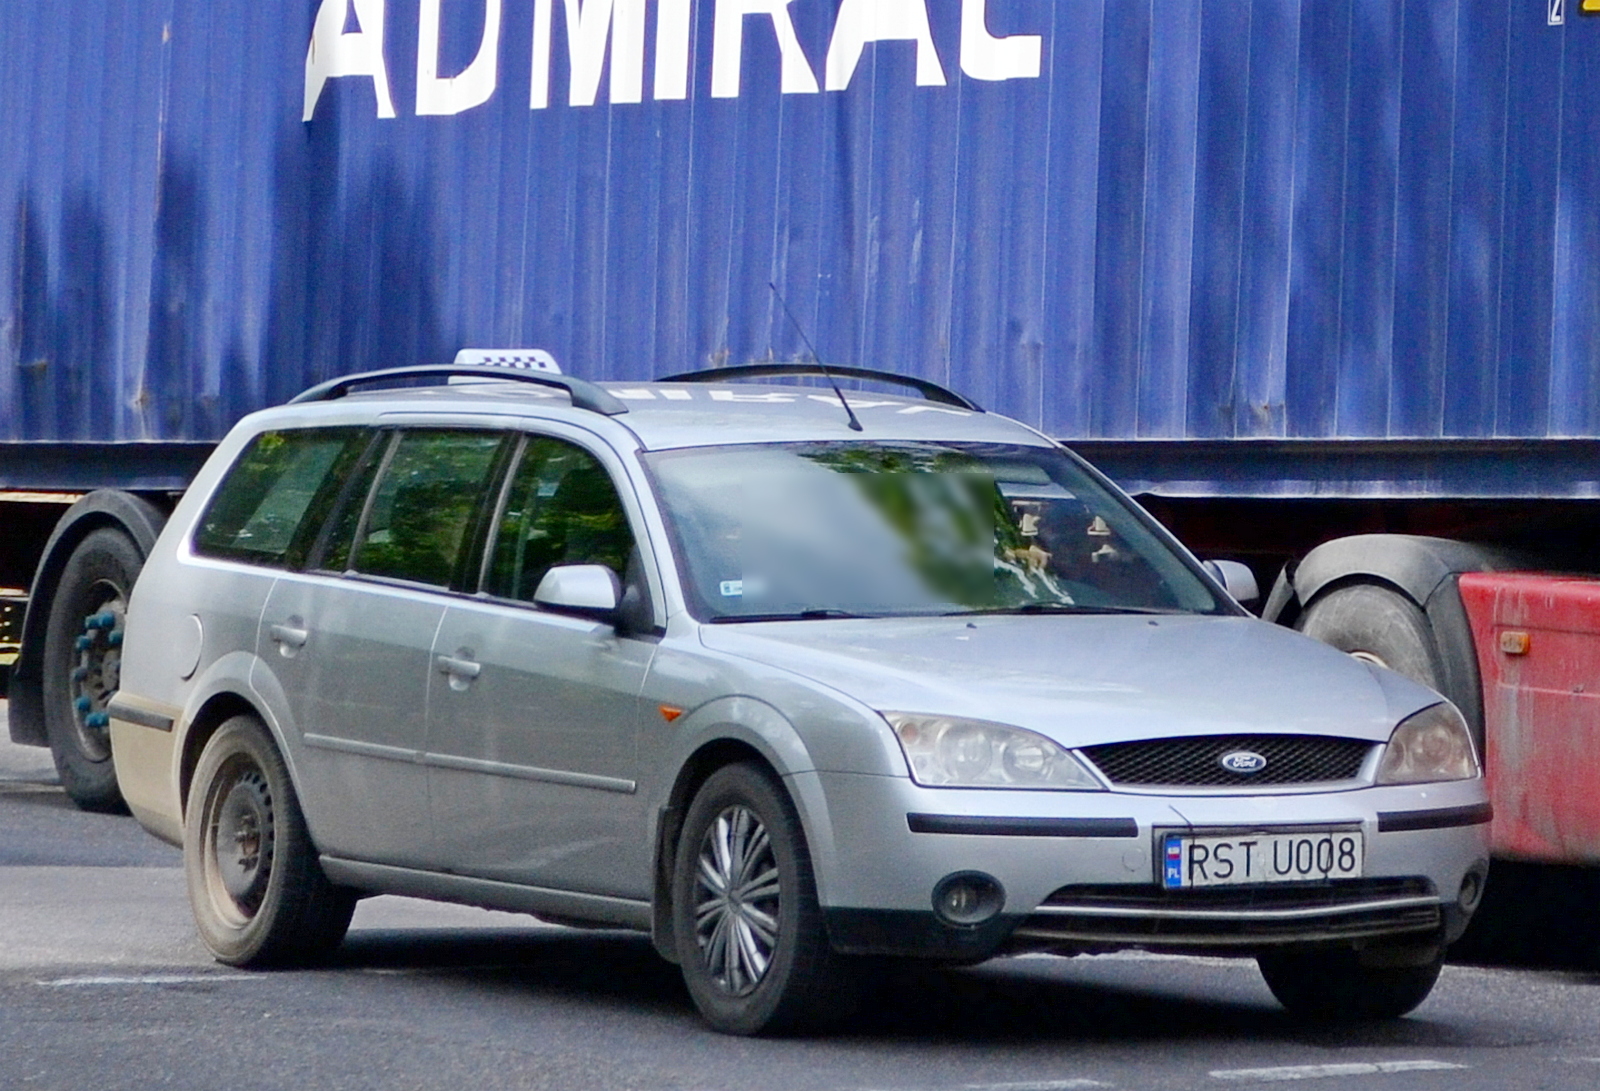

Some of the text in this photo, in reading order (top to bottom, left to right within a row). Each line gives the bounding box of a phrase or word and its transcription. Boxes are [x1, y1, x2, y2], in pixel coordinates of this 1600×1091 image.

[1232, 756, 1257, 768] Ford
[1188, 837, 1356, 880] RST U008
[1168, 868, 1180, 878] PL
